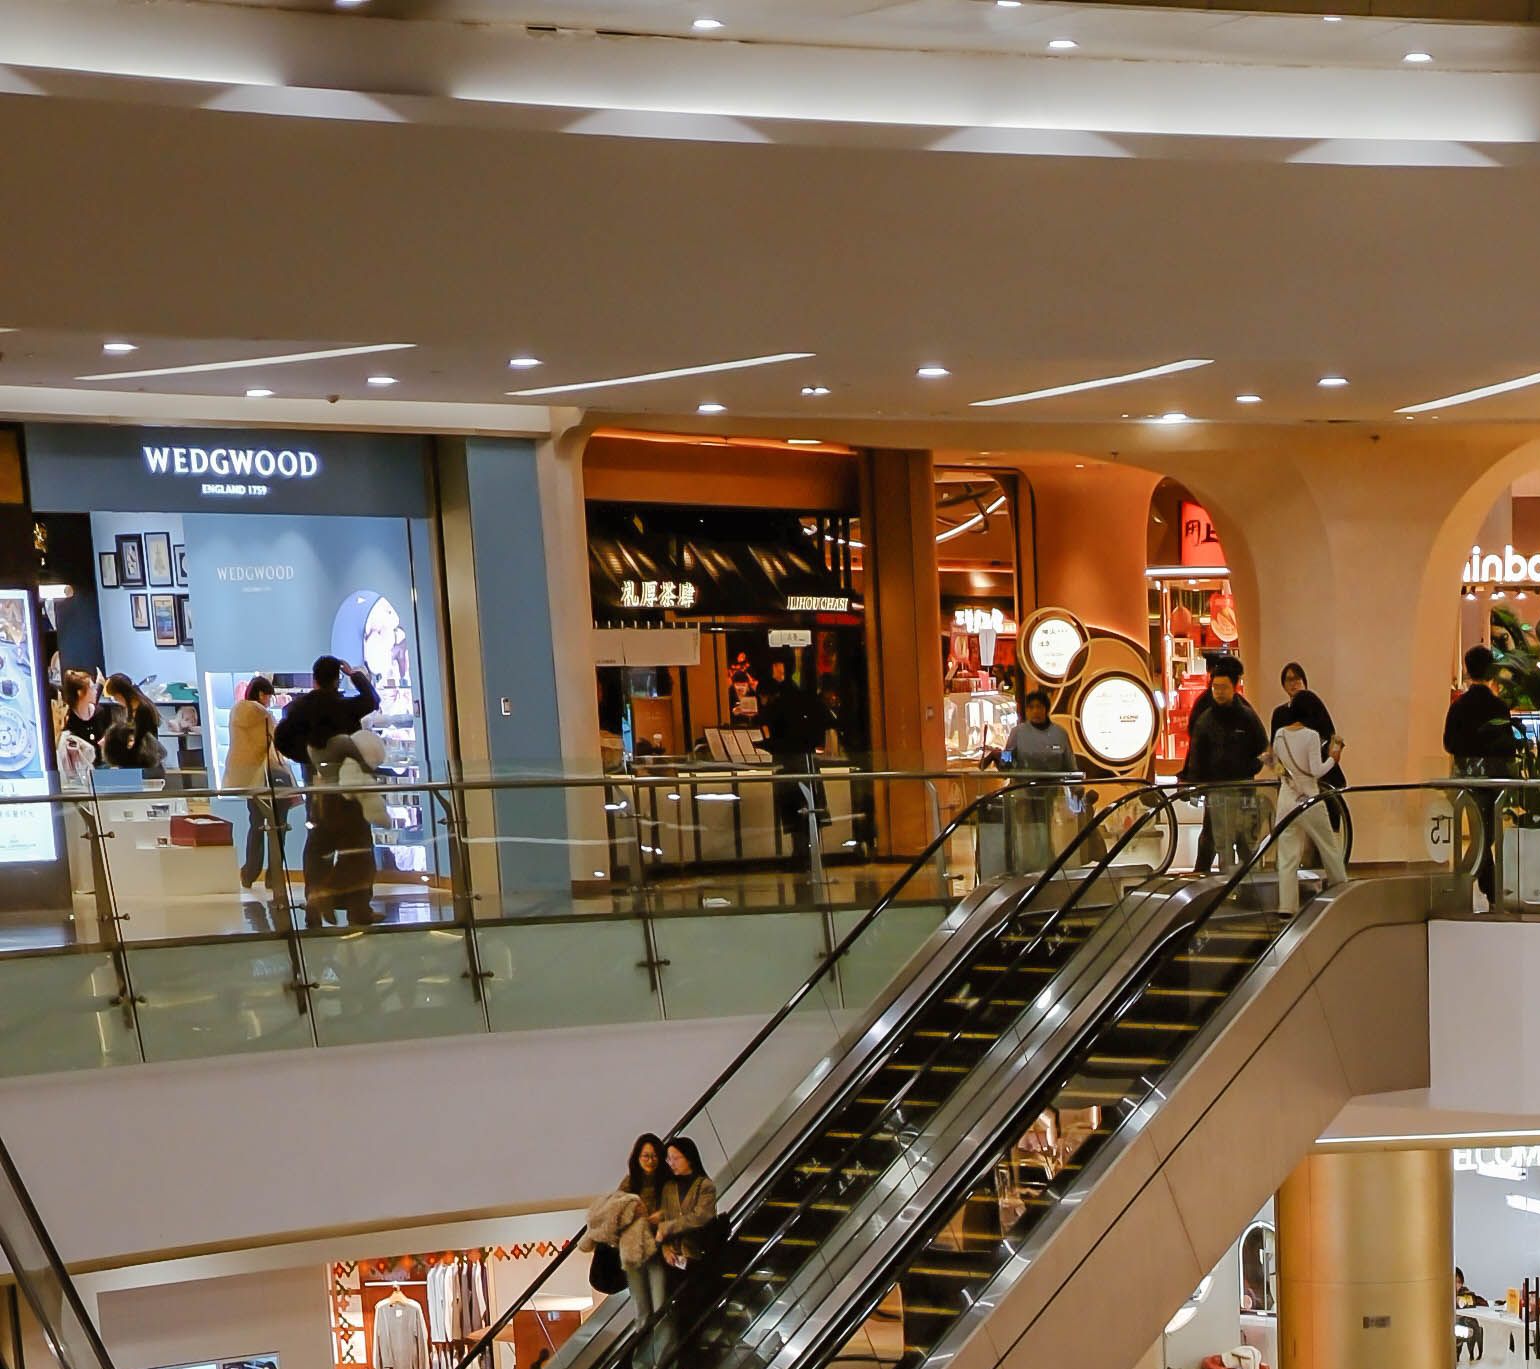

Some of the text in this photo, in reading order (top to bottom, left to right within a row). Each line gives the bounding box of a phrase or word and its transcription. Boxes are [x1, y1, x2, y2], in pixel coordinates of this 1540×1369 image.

[142, 446, 318, 477] WEDGWOOD
[202, 483, 246, 497] ENGLAND
[216, 566, 294, 581] WEDGWOOD
